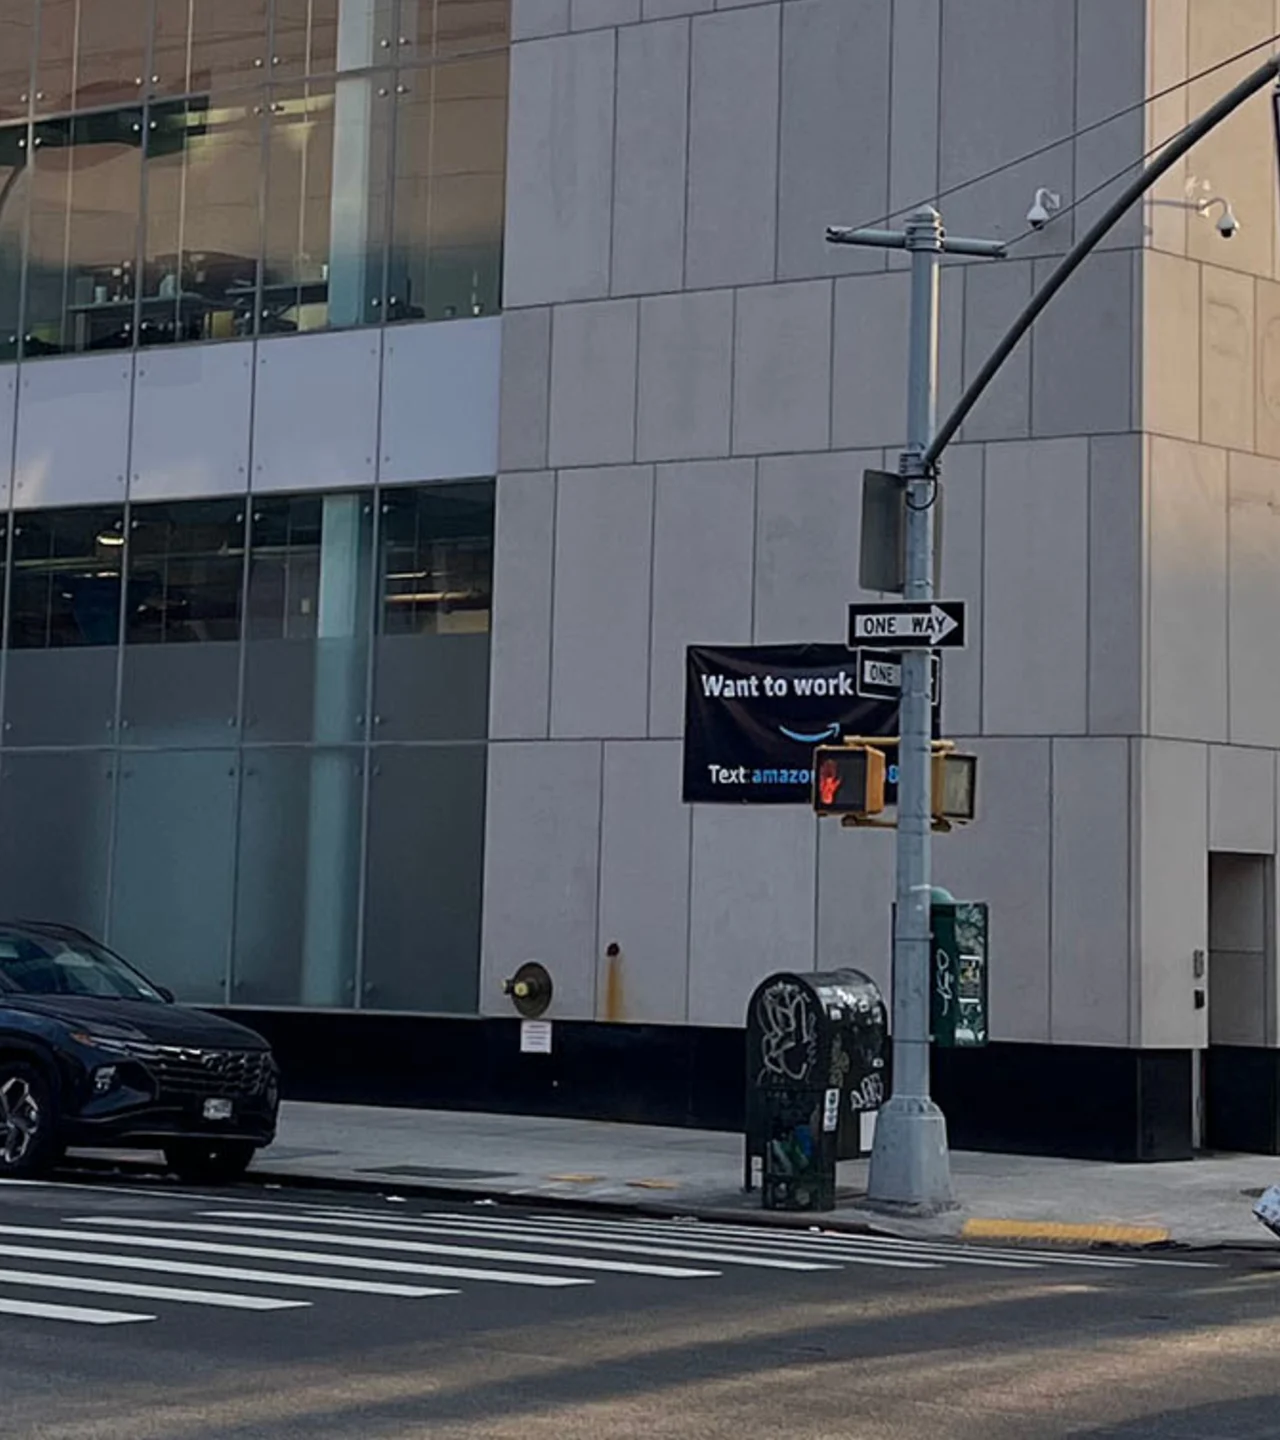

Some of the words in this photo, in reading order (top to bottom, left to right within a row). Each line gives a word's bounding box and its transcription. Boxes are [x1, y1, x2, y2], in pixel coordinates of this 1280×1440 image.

[864, 617, 896, 635] ONE
[912, 616, 947, 633] WAY
[701, 674, 760, 697] Want
[763, 675, 787, 696] to
[793, 671, 854, 696] work
[870, 664, 894, 684] ONE
[708, 764, 746, 784] Text
[752, 768, 816, 784] amazo
